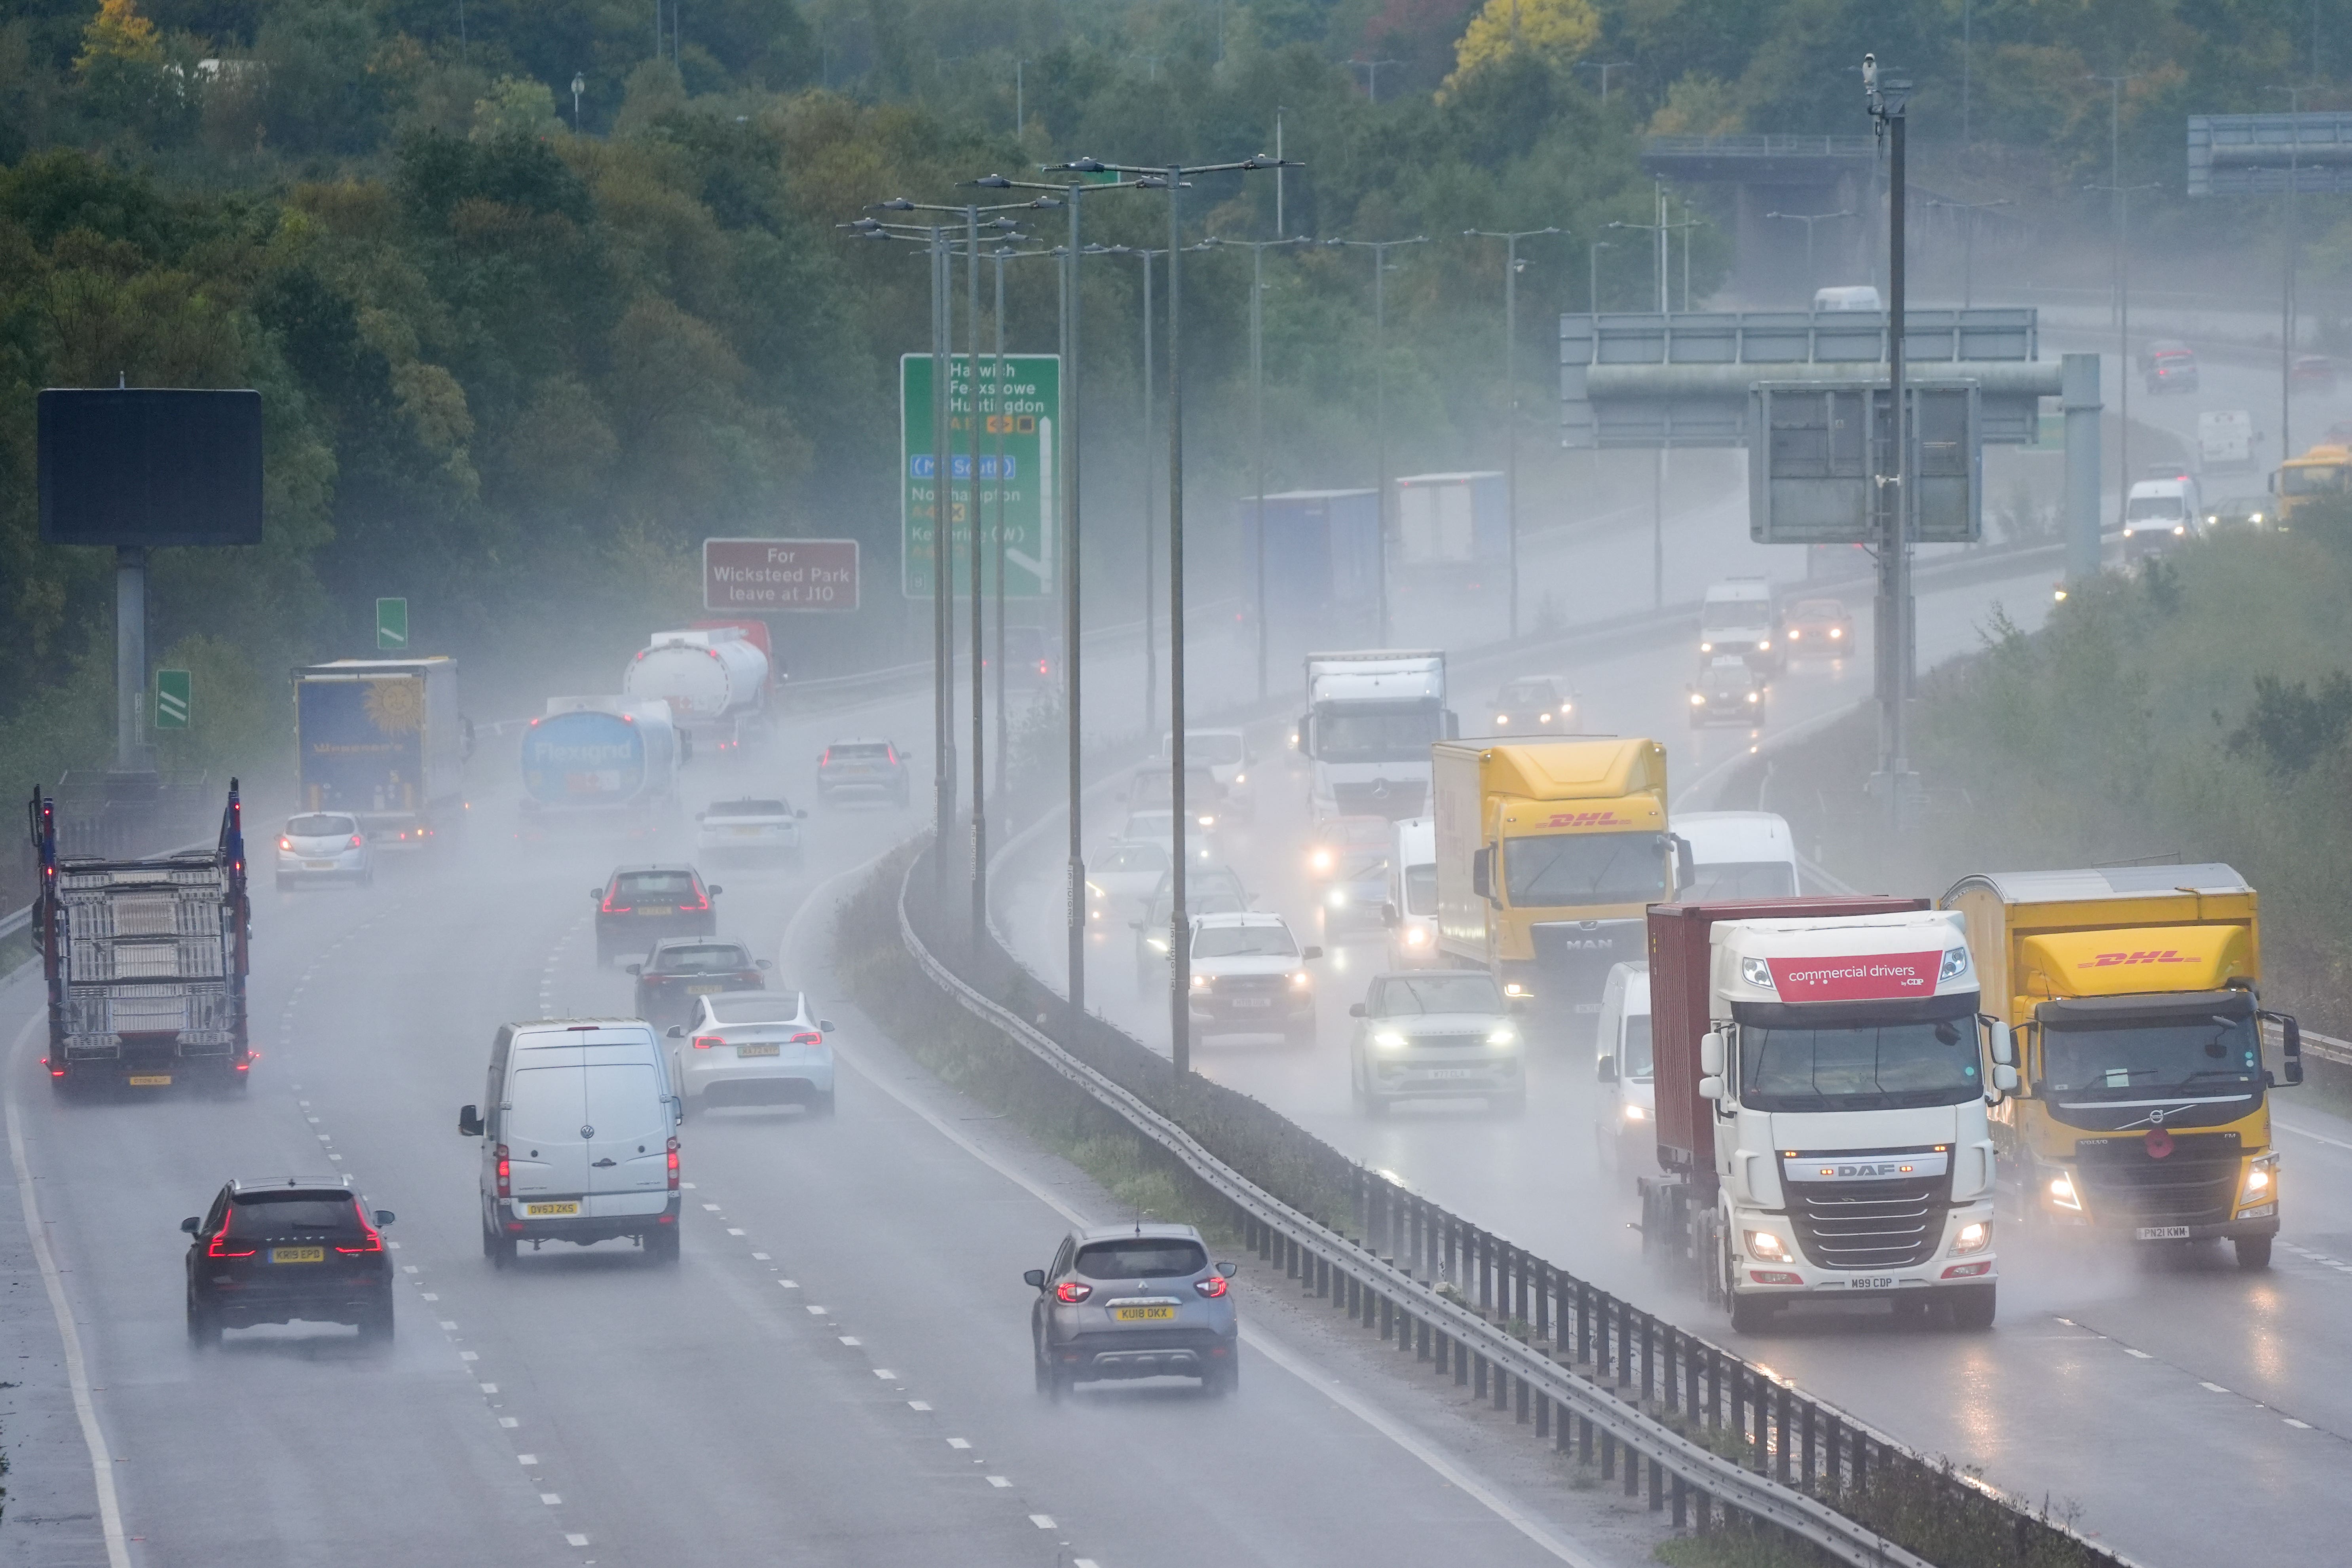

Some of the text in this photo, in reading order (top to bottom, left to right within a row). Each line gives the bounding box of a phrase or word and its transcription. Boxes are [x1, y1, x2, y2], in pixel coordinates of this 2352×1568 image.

[951, 363, 1015, 377] Hawih
[951, 380, 1036, 395] Fexsowe
[951, 397, 1044, 414] Hutigdon
[912, 487, 1020, 503] Nohapton
[912, 527, 986, 543] Kerig
[767, 548, 795, 563] For
[714, 567, 849, 582] Wicksteed Park
[730, 586, 833, 601] leave at J10
[535, 739, 632, 766] Flexigrid
[1548, 812, 1618, 827] DHL
[1567, 939, 1612, 950] MAN
[2095, 951, 2185, 966] DHL
[1789, 964, 1915, 982] commercial drivers
[1838, 1165, 1895, 1177] DAF
[556, 1204, 574, 1213] ZKS
[2144, 1228, 2185, 1237] PN21 KWM
[1852, 1278, 1892, 1288] M99 CDP
[1122, 1308, 1167, 1318] KU18 OKX
